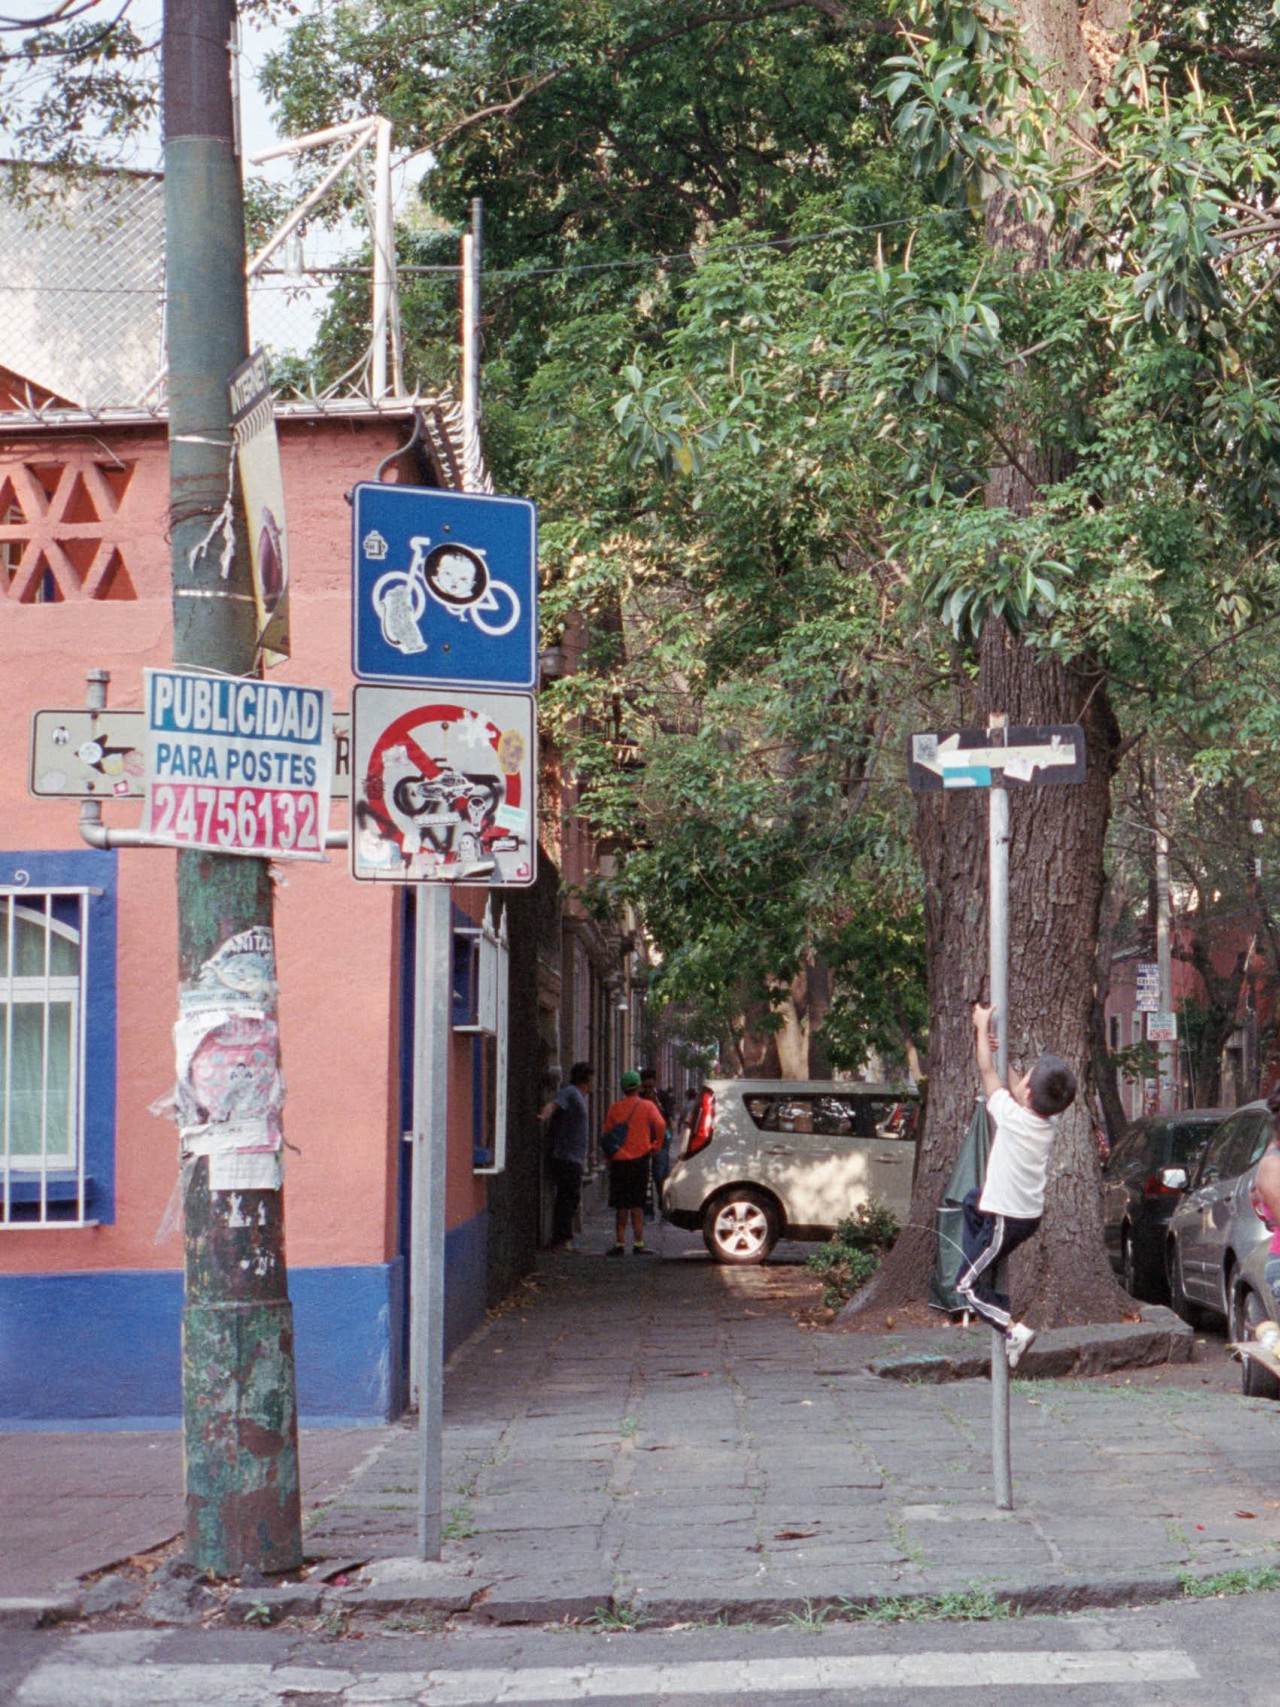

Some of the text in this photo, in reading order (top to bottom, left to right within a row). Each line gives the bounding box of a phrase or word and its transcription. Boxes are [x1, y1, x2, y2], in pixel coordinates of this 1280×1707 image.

[154, 676, 321, 740] PUBLICIDAD
[156, 743, 317, 787] PARA POSTES
[154, 785, 318, 849] 24756132
